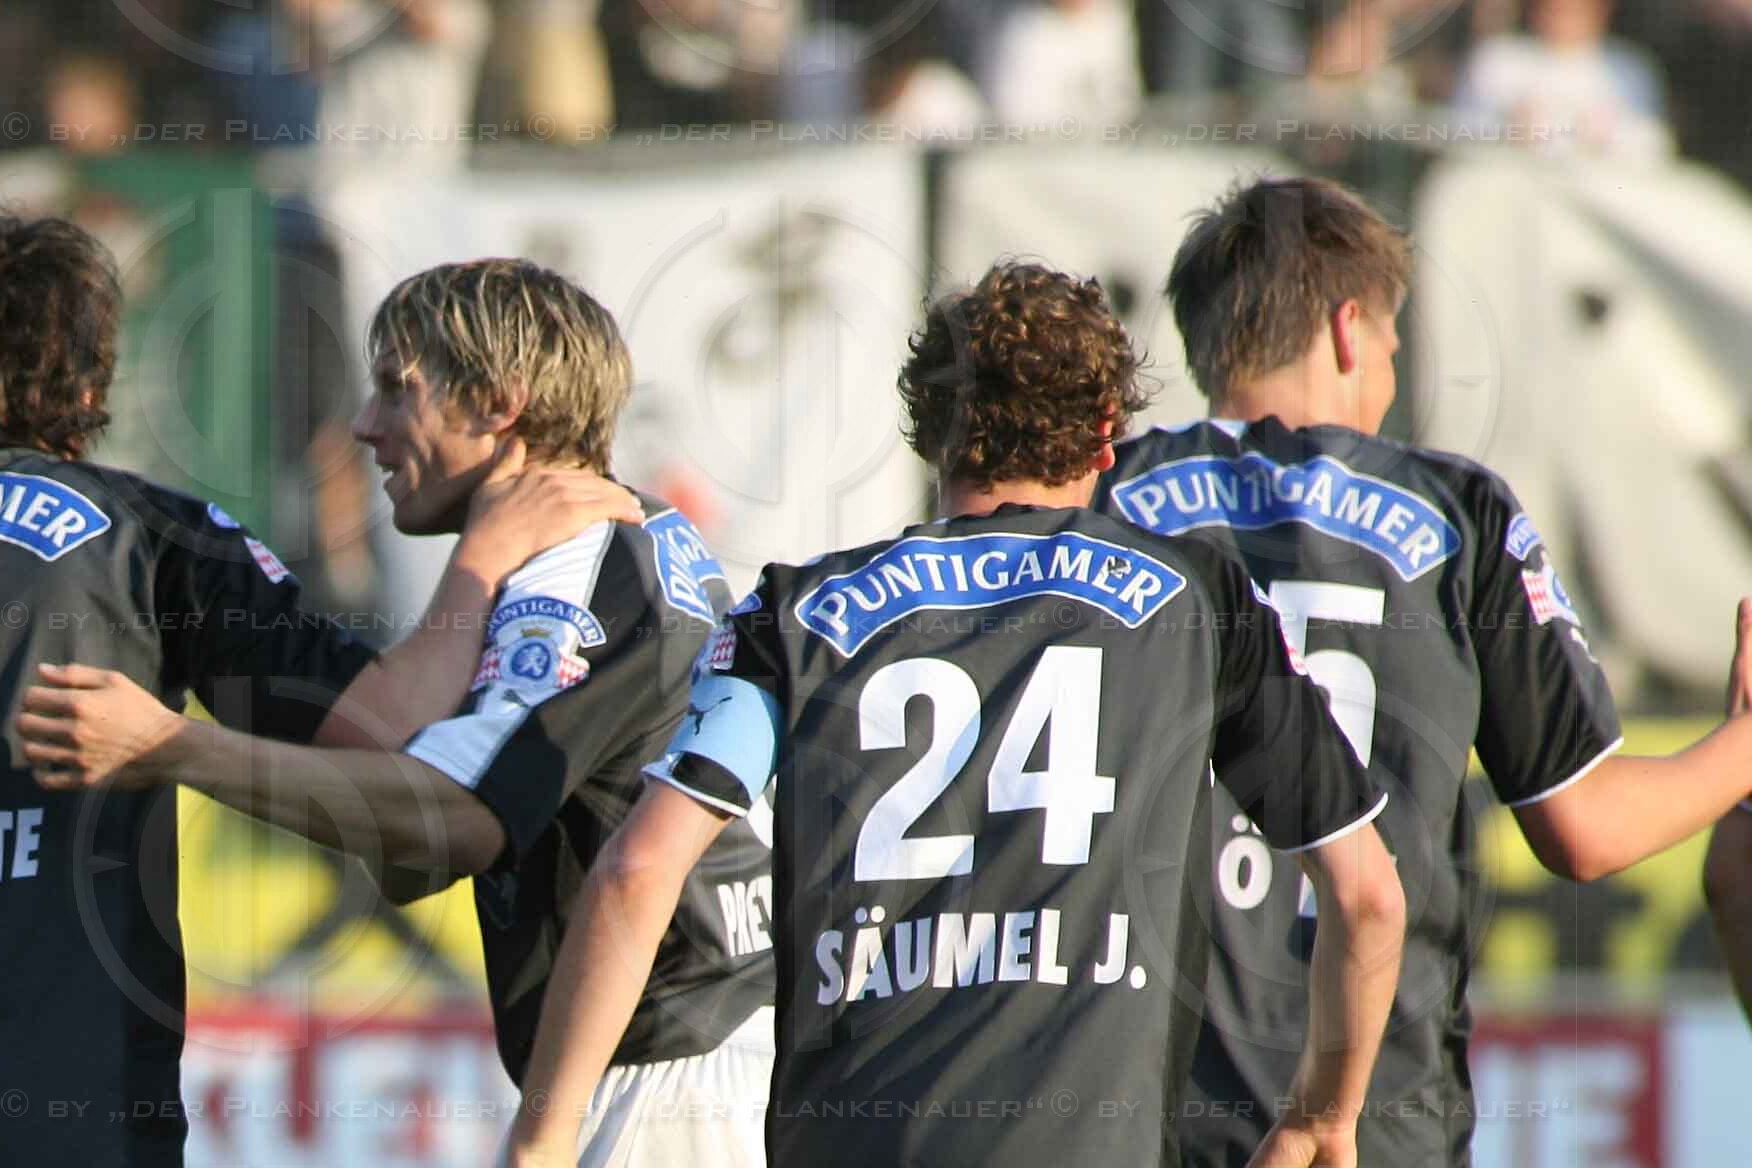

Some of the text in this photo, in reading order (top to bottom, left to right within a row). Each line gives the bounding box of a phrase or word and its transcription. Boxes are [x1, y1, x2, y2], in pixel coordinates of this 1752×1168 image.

[1129, 470, 1442, 570] PUNTIGAMER
[812, 544, 1163, 636] PUNTIGAMER
[854, 645, 1116, 882] 24
[815, 905, 1147, 1006] SÄUMEL J.
